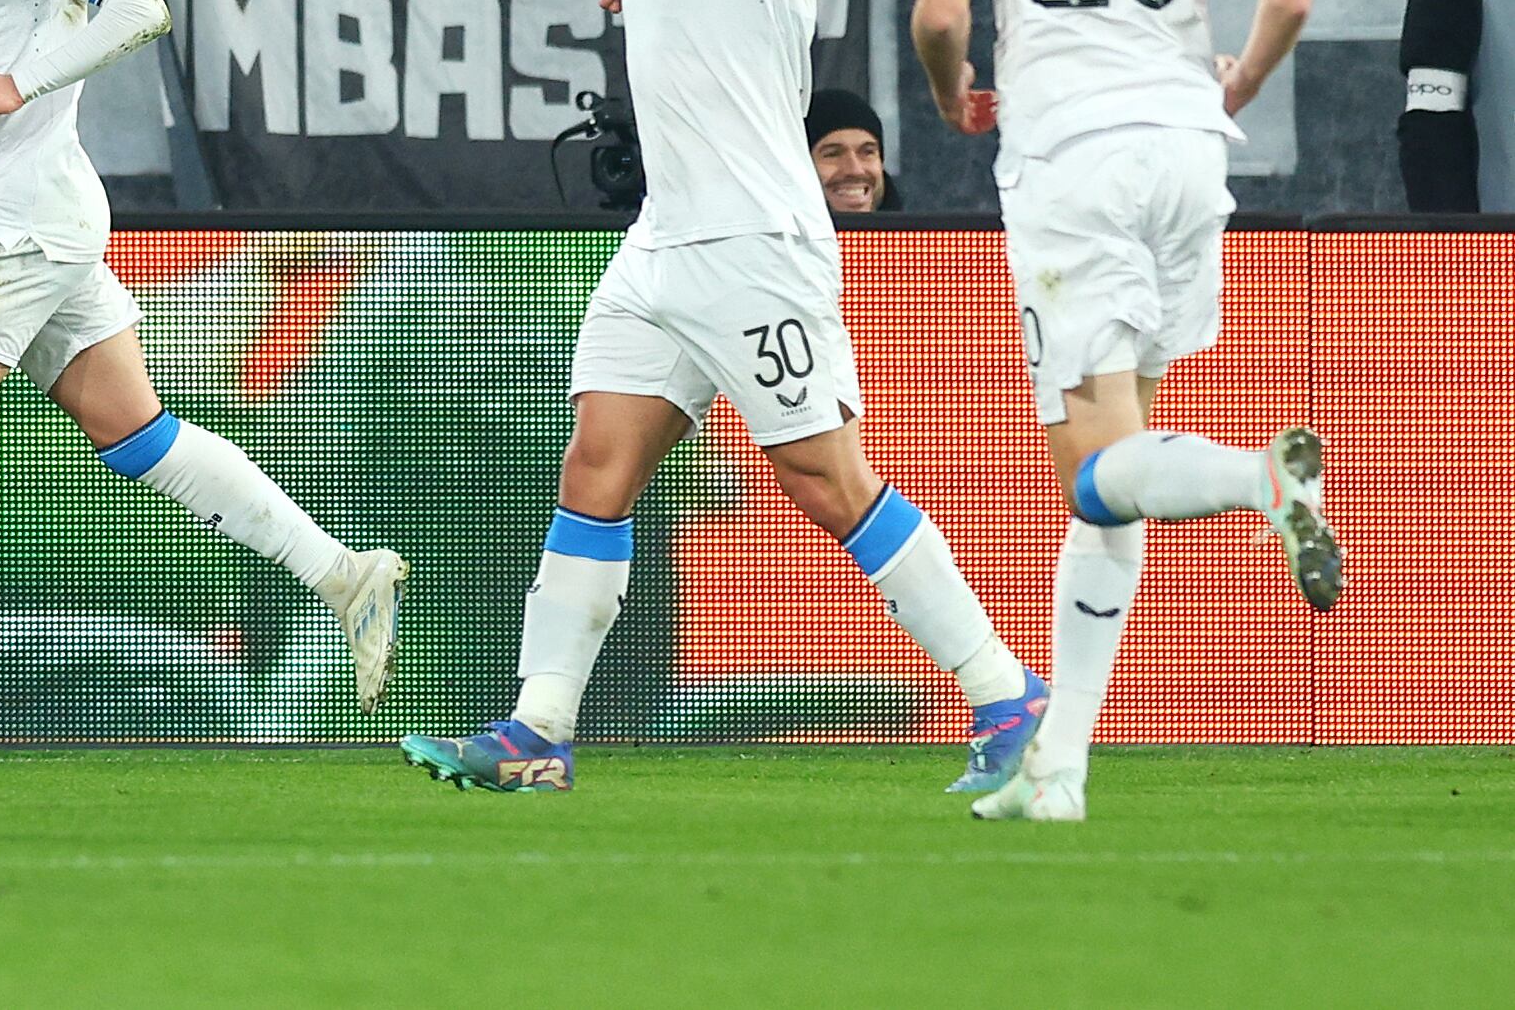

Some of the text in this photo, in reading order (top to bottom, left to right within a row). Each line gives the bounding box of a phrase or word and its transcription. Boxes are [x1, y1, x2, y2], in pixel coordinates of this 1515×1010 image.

[1409, 83, 1453, 96] ppo
[742, 318, 815, 388] 30
[1024, 306, 1043, 368] 0
